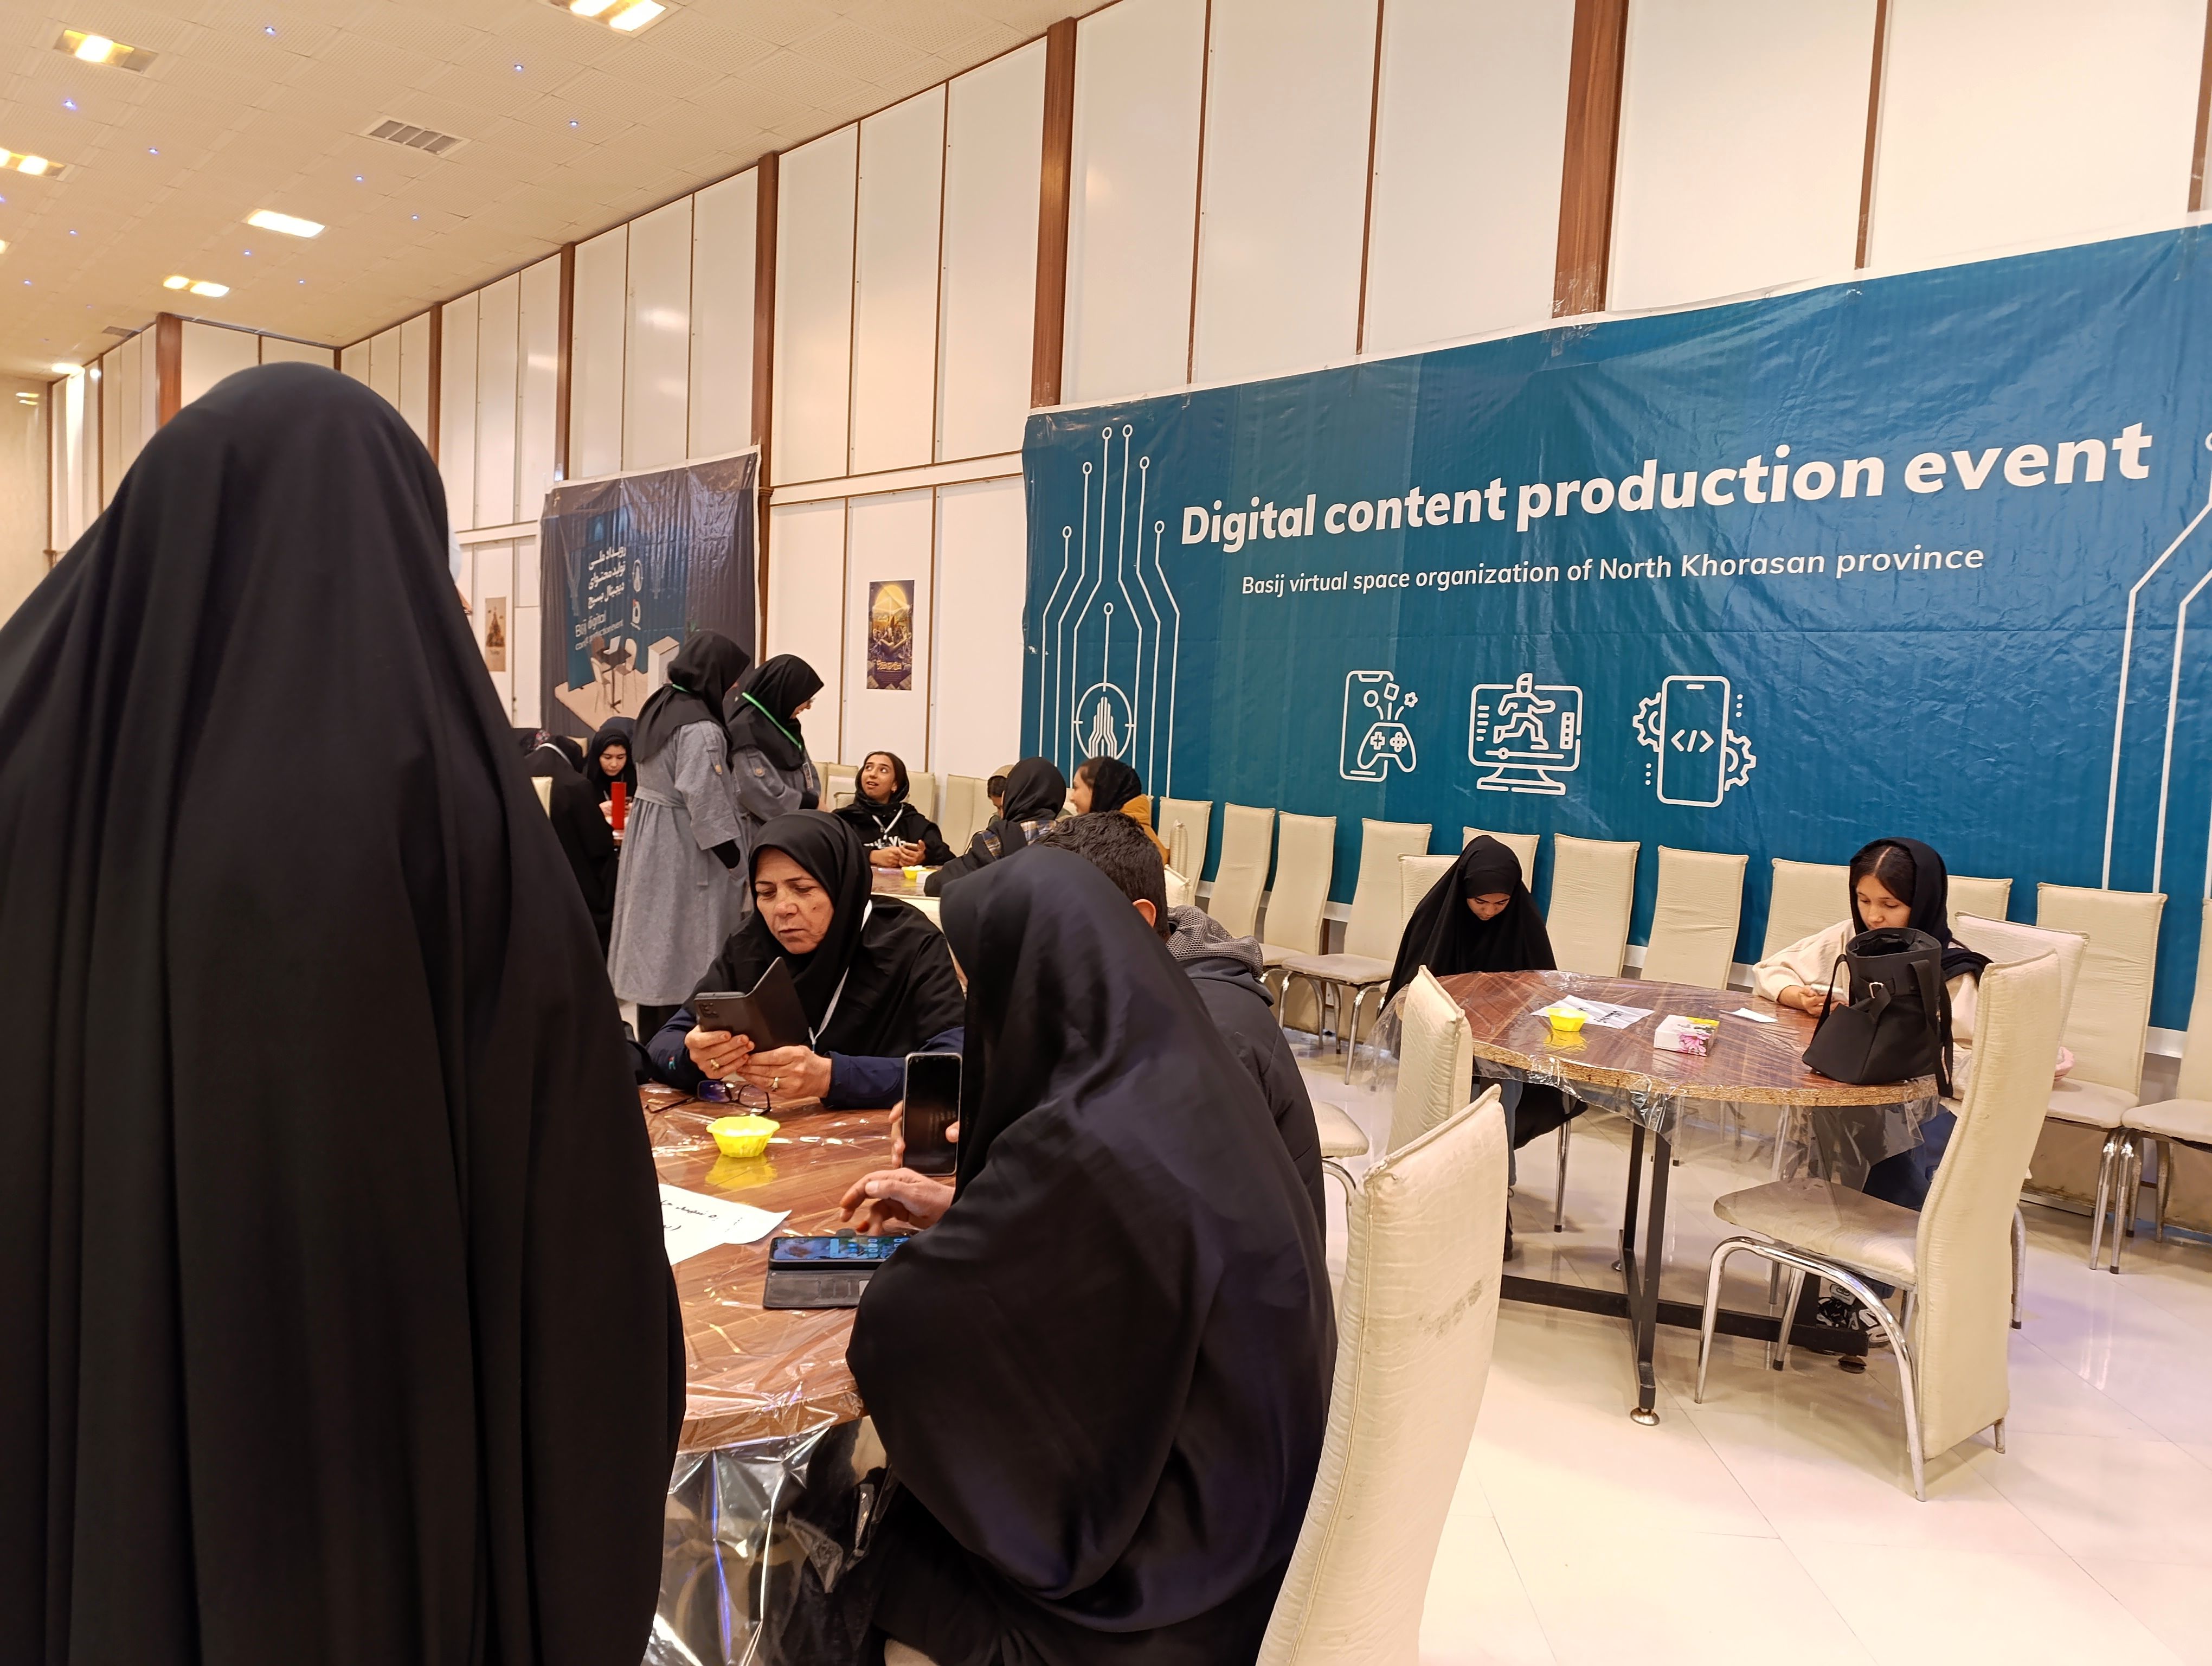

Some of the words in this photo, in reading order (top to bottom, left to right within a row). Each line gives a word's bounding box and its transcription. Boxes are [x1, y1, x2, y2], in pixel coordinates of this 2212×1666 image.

[1181, 494, 1317, 554] Digital
[1323, 477, 1507, 535] content
[1516, 444, 1885, 533] production
[1904, 422, 2153, 494] event
[1242, 575, 1284, 598] Basij
[1289, 571, 1348, 593] virtual
[1353, 573, 1410, 595] space
[1416, 560, 1559, 592] organization
[1567, 558, 1593, 581] of
[1600, 554, 1671, 580] North
[1681, 553, 1825, 577] Khorasan
[1836, 544, 1984, 579] province
